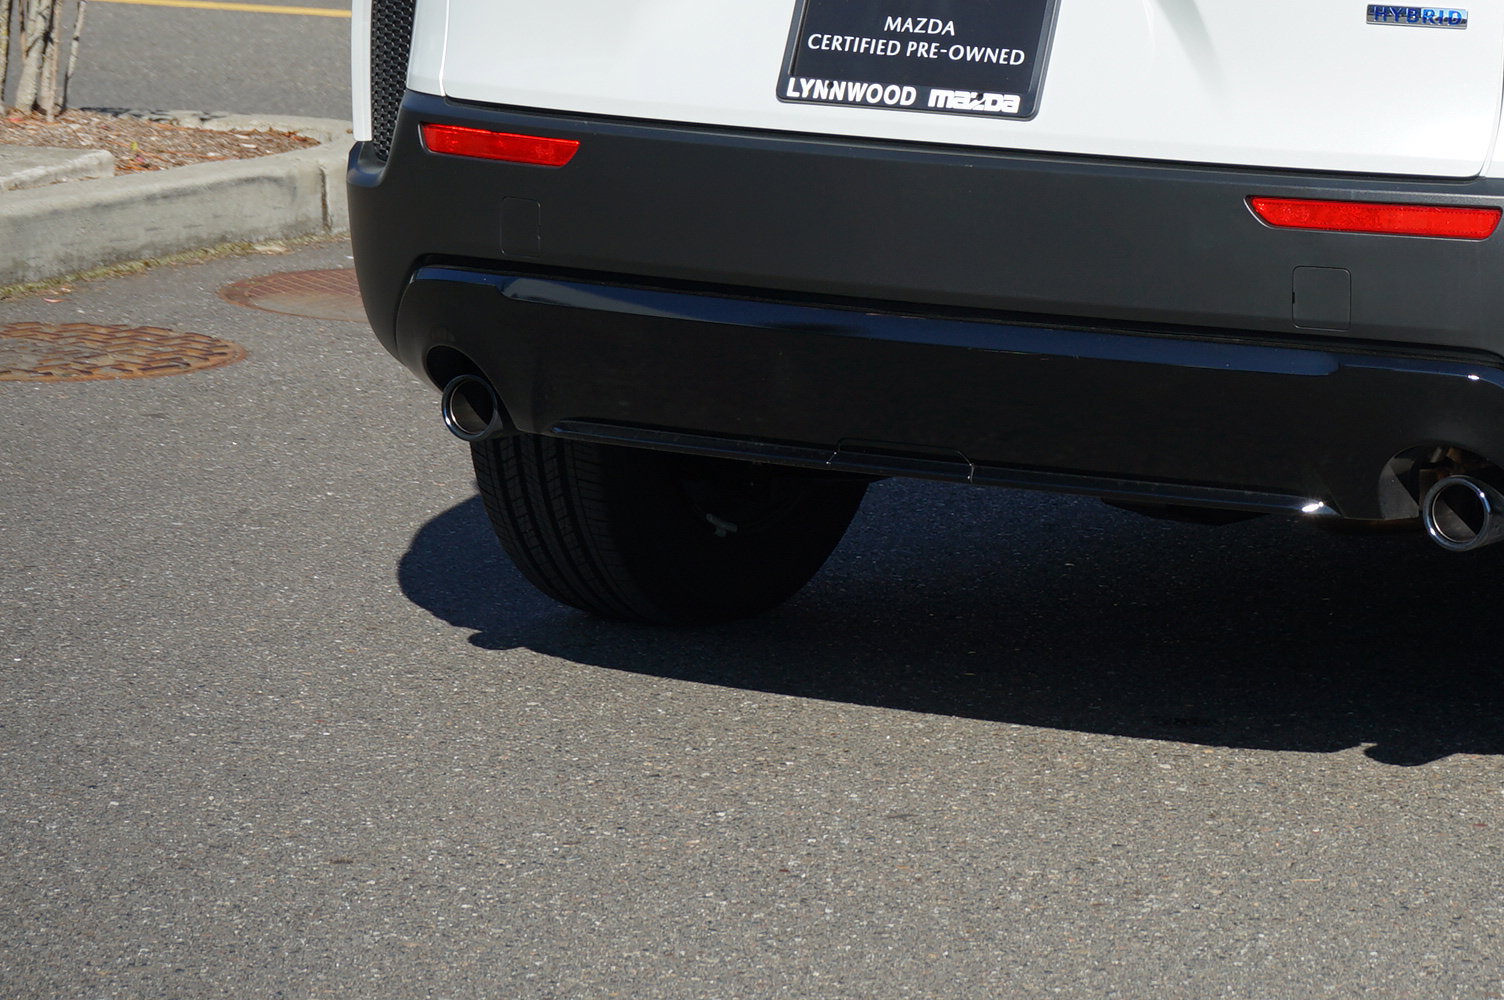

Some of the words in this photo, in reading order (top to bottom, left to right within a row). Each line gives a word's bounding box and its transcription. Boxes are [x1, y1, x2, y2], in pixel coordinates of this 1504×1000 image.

[884, 16, 956, 36] MAZDA
[1373, 5, 1463, 26] HYBRID
[807, 33, 901, 56] CERTIFIED
[906, 42, 1025, 66] PRE-OWNED
[786, 76, 917, 106] LYNNWOOD
